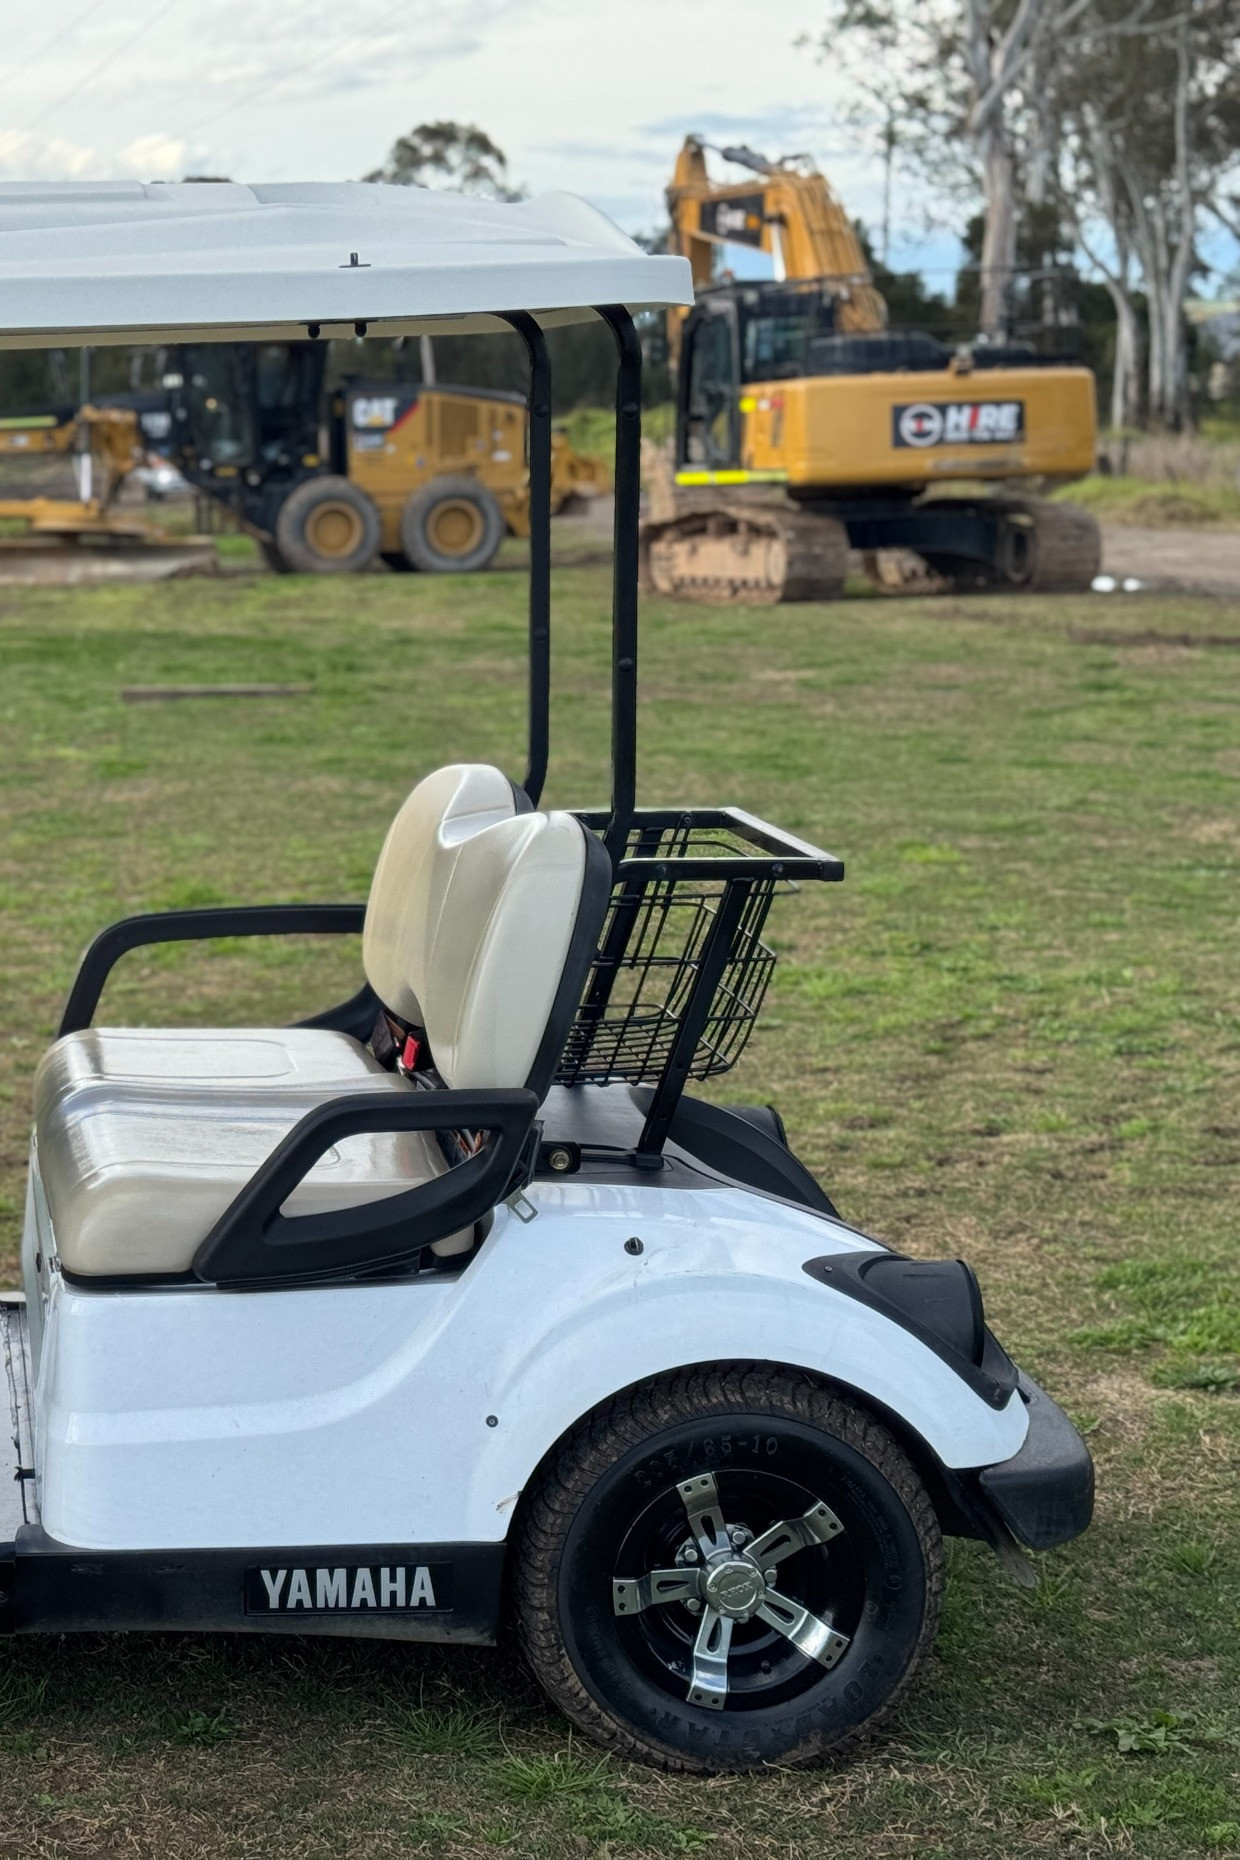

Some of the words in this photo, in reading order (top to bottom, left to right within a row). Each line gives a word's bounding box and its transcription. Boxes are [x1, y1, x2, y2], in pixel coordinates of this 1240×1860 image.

[353, 398, 397, 428] CAT
[946, 403, 1020, 431] HIRE
[261, 1566, 436, 1609] YAMAHA
